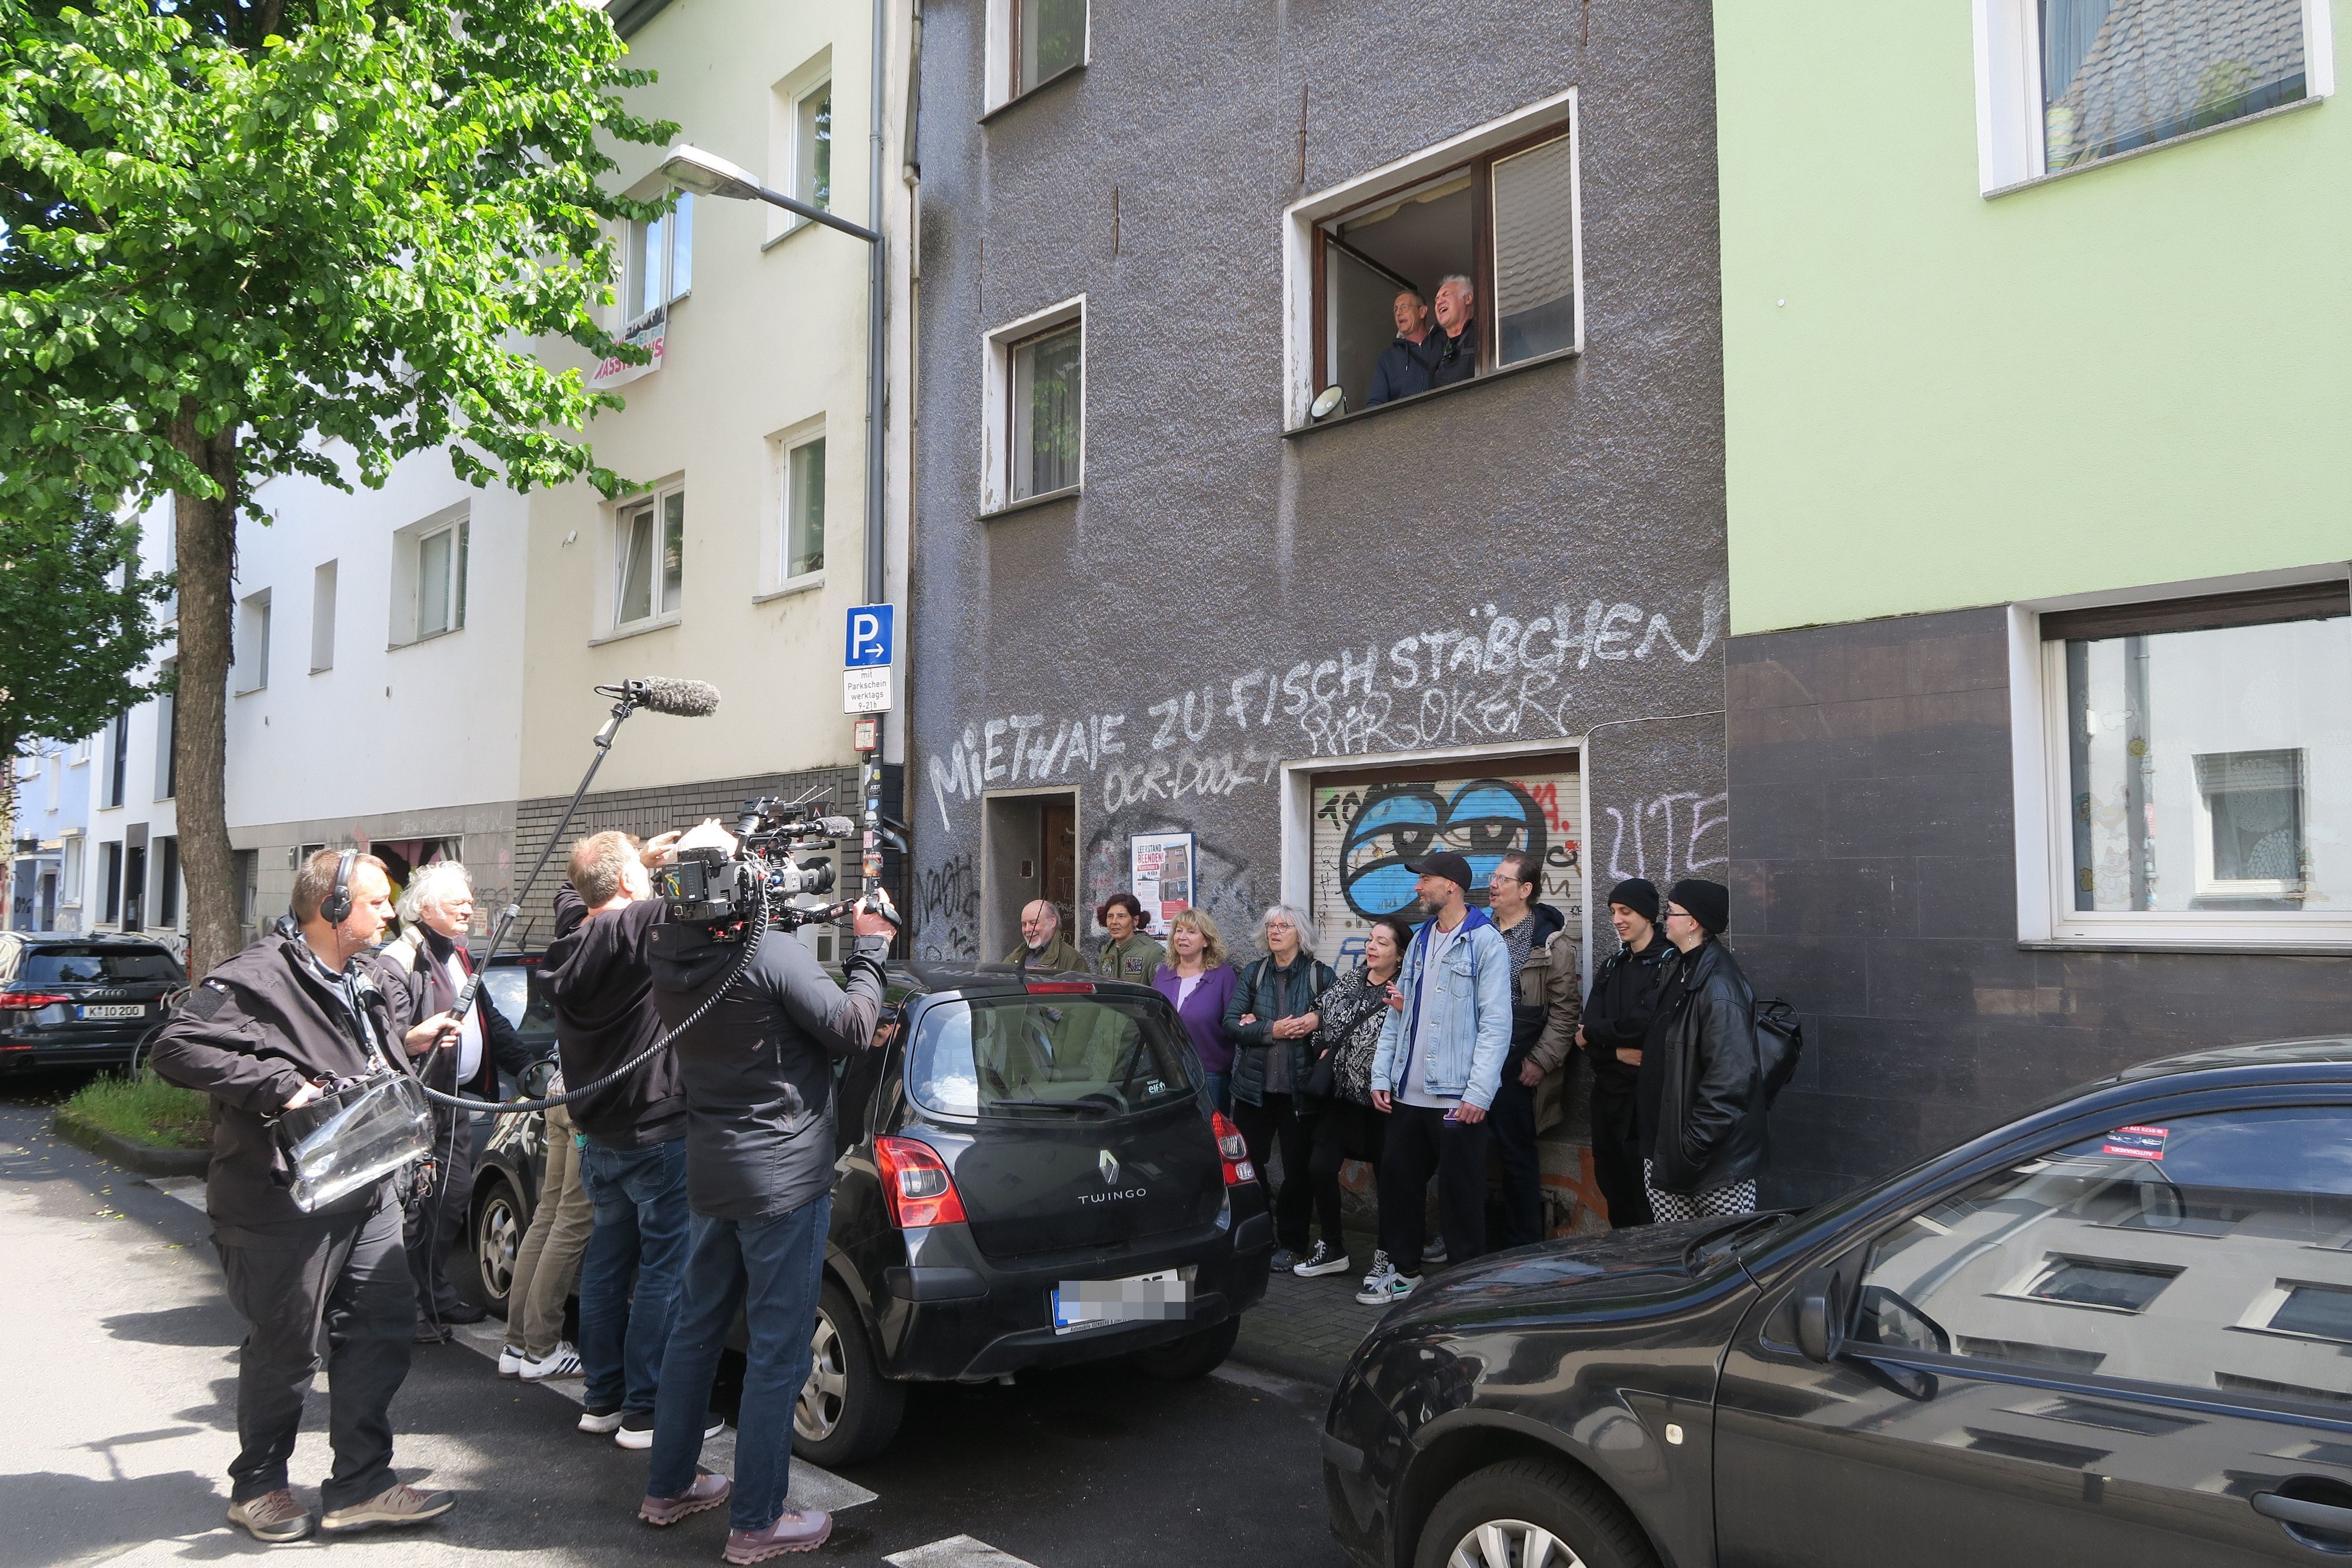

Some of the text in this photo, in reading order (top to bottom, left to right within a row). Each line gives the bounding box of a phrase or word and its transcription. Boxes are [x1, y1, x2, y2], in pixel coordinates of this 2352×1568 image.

[853, 614, 878, 659] P
[861, 671, 873, 679] mit
[847, 680, 887, 691] Parkschein
[851, 691, 884, 701] werktags
[1148, 685, 1214, 750] ZU
[1226, 647, 1380, 729] FISCH
[1137, 844, 1162, 854] LEERSTAND
[1138, 852, 1164, 864] BEENDEN!
[89, 1007, 96, 1017] K
[118, 1006, 139, 1016] 200
[1148, 1084, 1160, 1093] elf
[2109, 1146, 2153, 1156] AUTOHANDEL
[1077, 1188, 1147, 1205] TWINGO
[1070, 1323, 1091, 1332] Automobile
